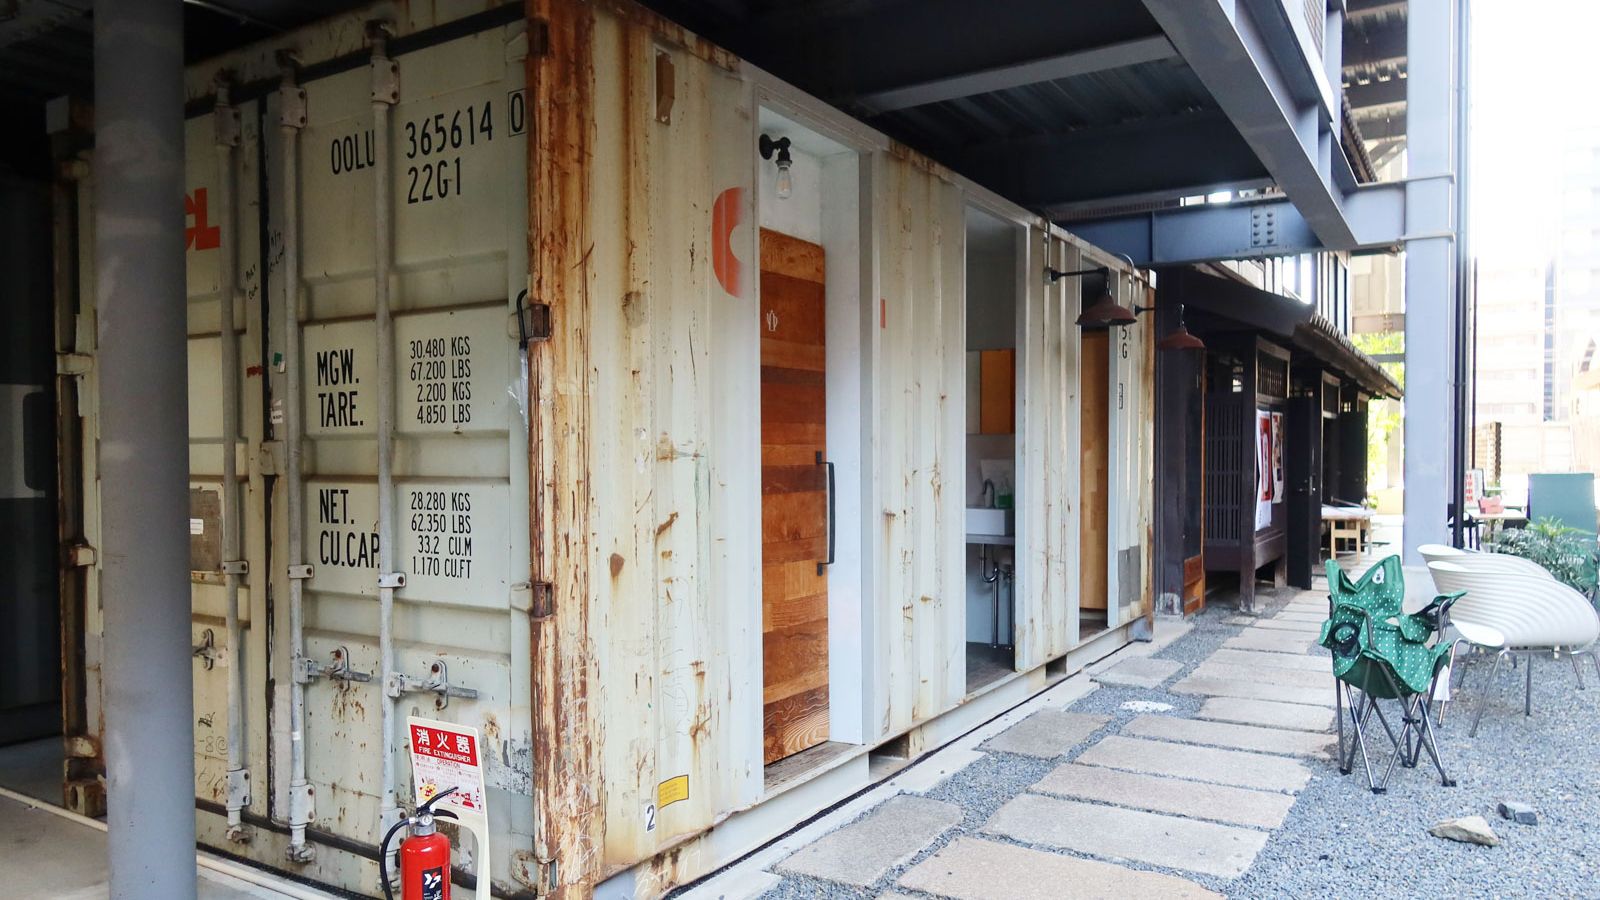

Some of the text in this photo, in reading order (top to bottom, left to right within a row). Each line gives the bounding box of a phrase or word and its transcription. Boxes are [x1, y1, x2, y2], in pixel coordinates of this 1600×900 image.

[405, 100, 493, 160] 365614
[510, 92, 525, 133] 0
[407, 156, 462, 205] 22G1
[409, 335, 471, 360] 30.480 KGS
[316, 348, 360, 387] MGW.
[410, 358, 471, 381] 67.200 LBS
[416, 381, 472, 403] 2.200 KGS
[318, 391, 364, 428] TARE.
[416, 403, 471, 424] 4.850 LBS
[319, 488, 355, 525] NET.
[410, 491, 471, 512] 28.280 KGS
[410, 513, 472, 535] 62.350 LBS
[417, 534, 472, 557] 33.2 CU.M
[412, 556, 472, 579] 1.170 CU.FT
[416, 728, 471, 755] 消火器
[418, 746, 432, 756] FIRE
[433, 749, 471, 764] EXTINGUISHER
[646, 804, 655, 832] 2
